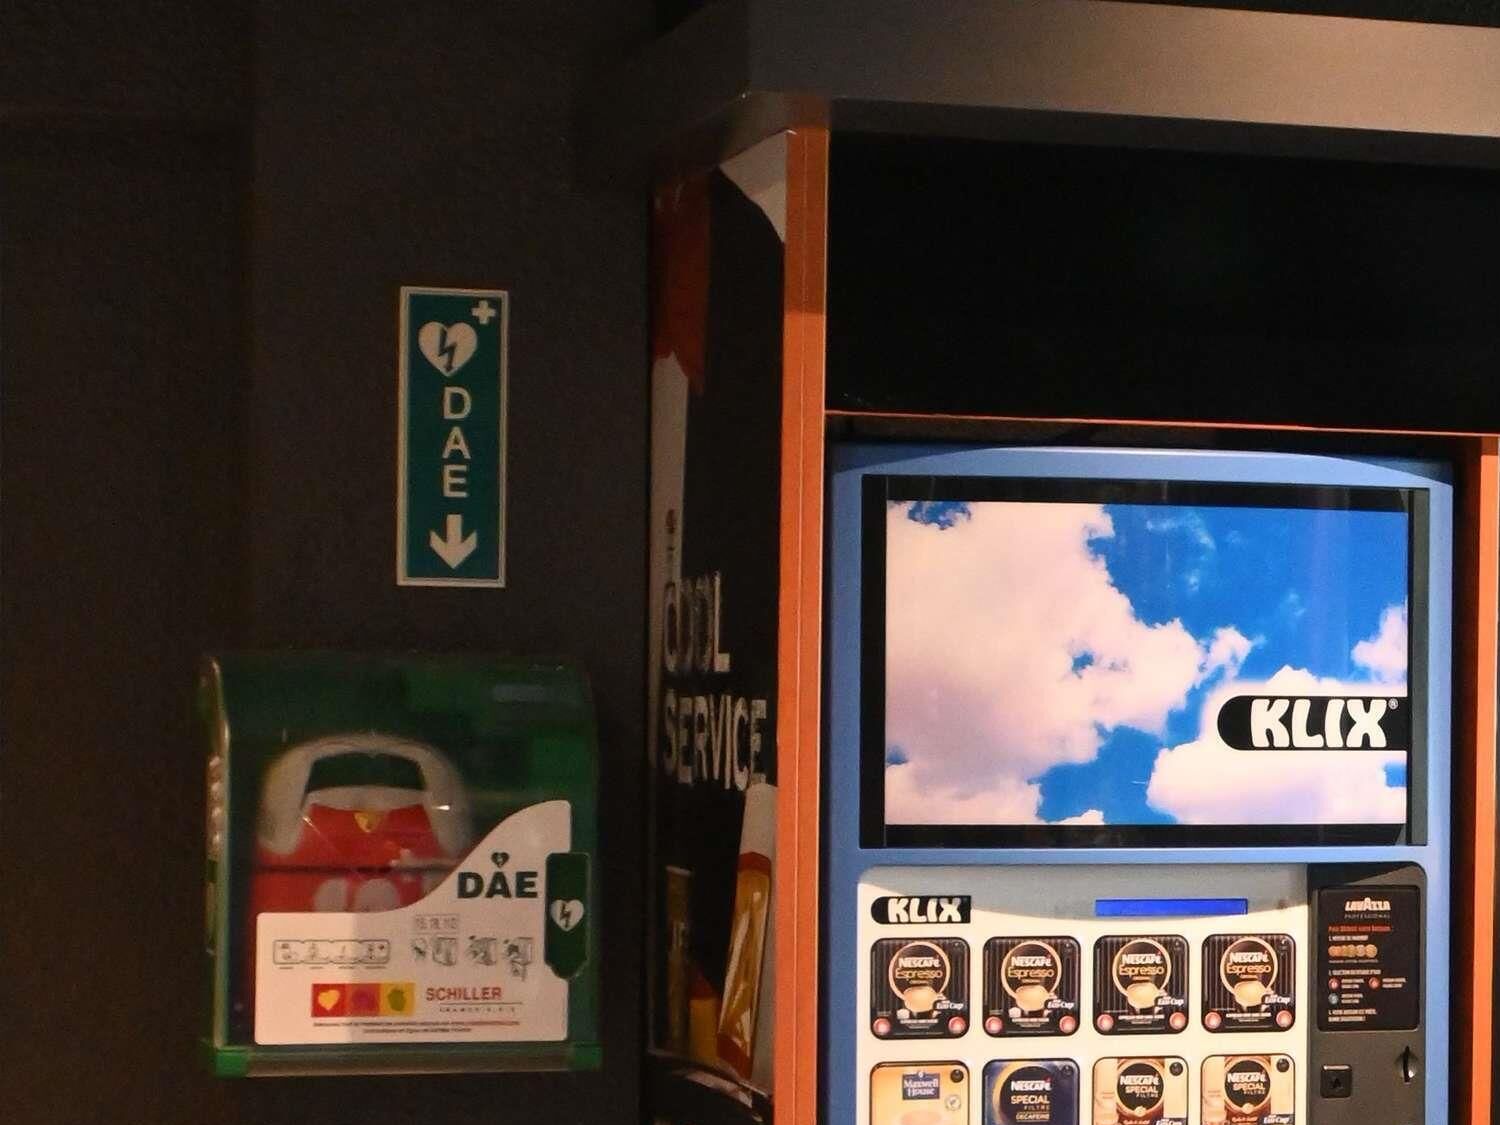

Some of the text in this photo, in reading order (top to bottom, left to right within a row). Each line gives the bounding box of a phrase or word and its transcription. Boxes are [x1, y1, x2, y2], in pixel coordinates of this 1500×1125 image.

[442, 386, 472, 498] DAE
[1250, 698, 1388, 748] KLIX
[664, 689, 767, 791] SERVICE
[458, 871, 538, 899] DAE
[888, 898, 962, 923] KLIX
[1344, 897, 1391, 911] LAVAZZA
[896, 968, 942, 980] Espresso
[1008, 968, 1054, 980] Espresso
[1119, 964, 1164, 976] Espresso
[1227, 963, 1271, 975] Espresso
[426, 987, 501, 1001] SCHILLER
